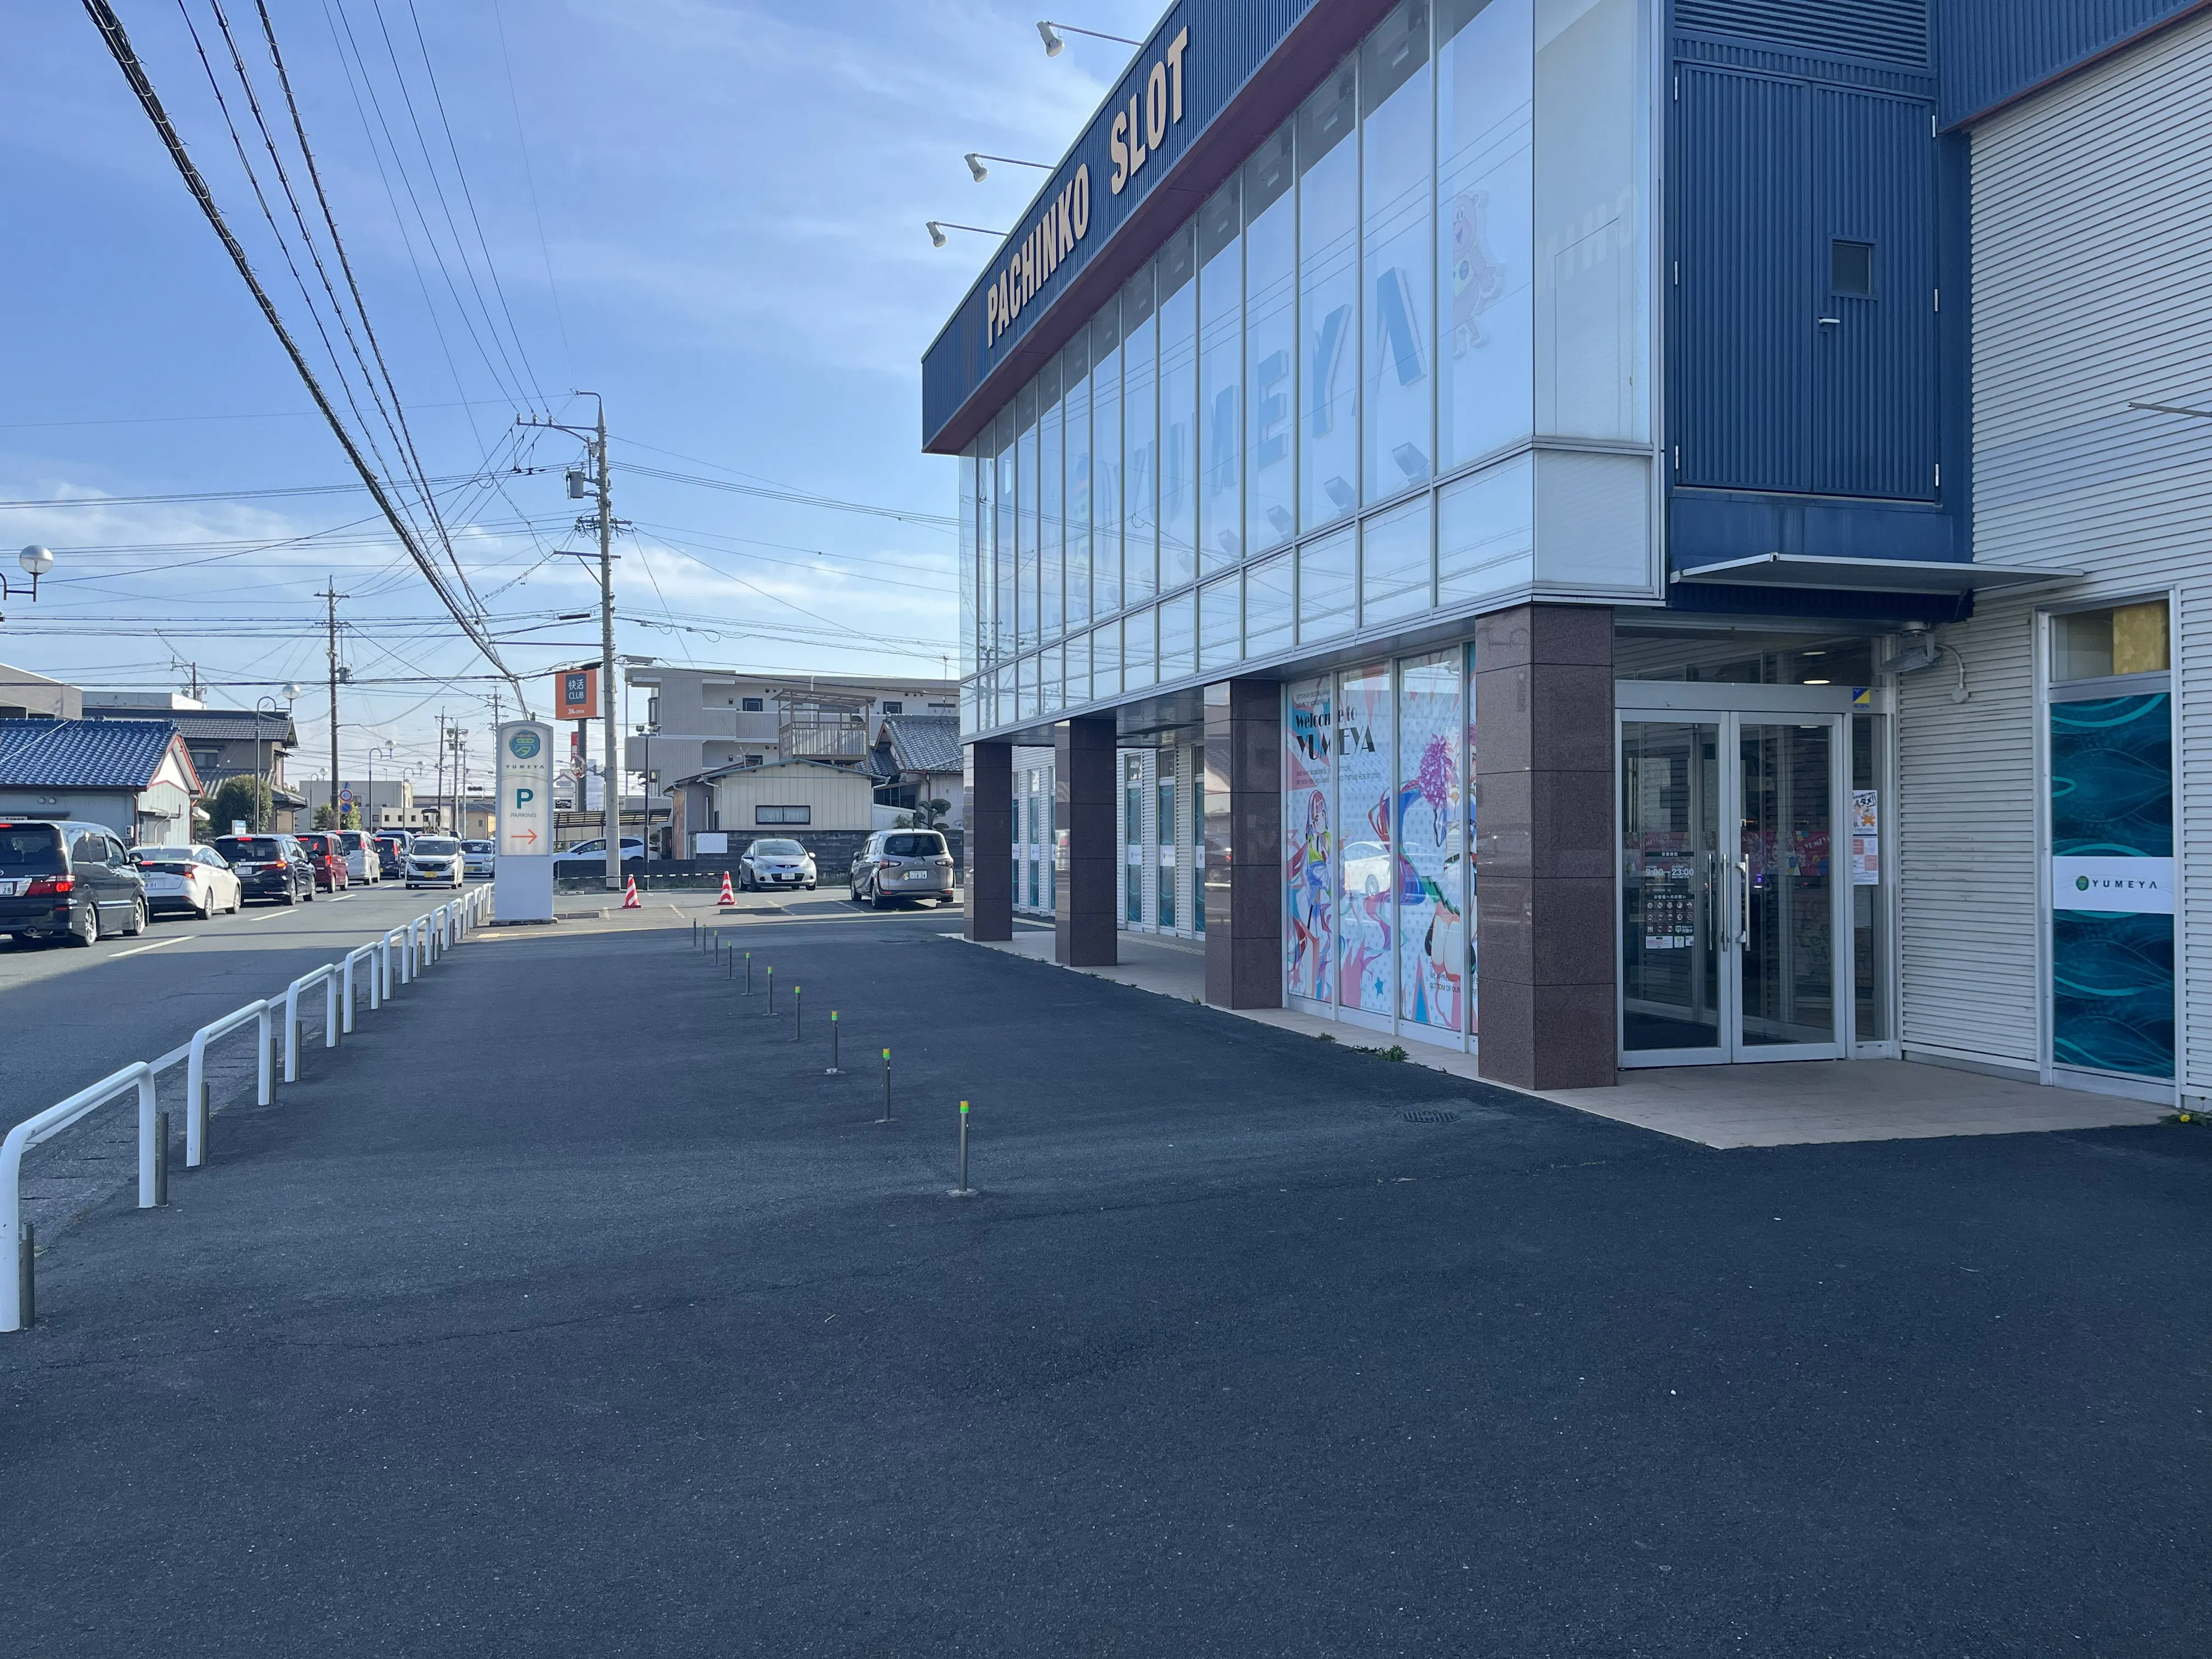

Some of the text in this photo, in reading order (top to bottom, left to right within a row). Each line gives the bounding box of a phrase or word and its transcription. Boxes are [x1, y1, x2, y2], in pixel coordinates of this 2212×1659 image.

[988, 25, 1188, 348] PACHINKO SLOT
[568, 678, 584, 690] 快活
[568, 691, 584, 699] CLUB
[1346, 704, 1357, 721] to
[517, 788, 533, 809] P
[2092, 880, 2158, 889] YUMEYA
